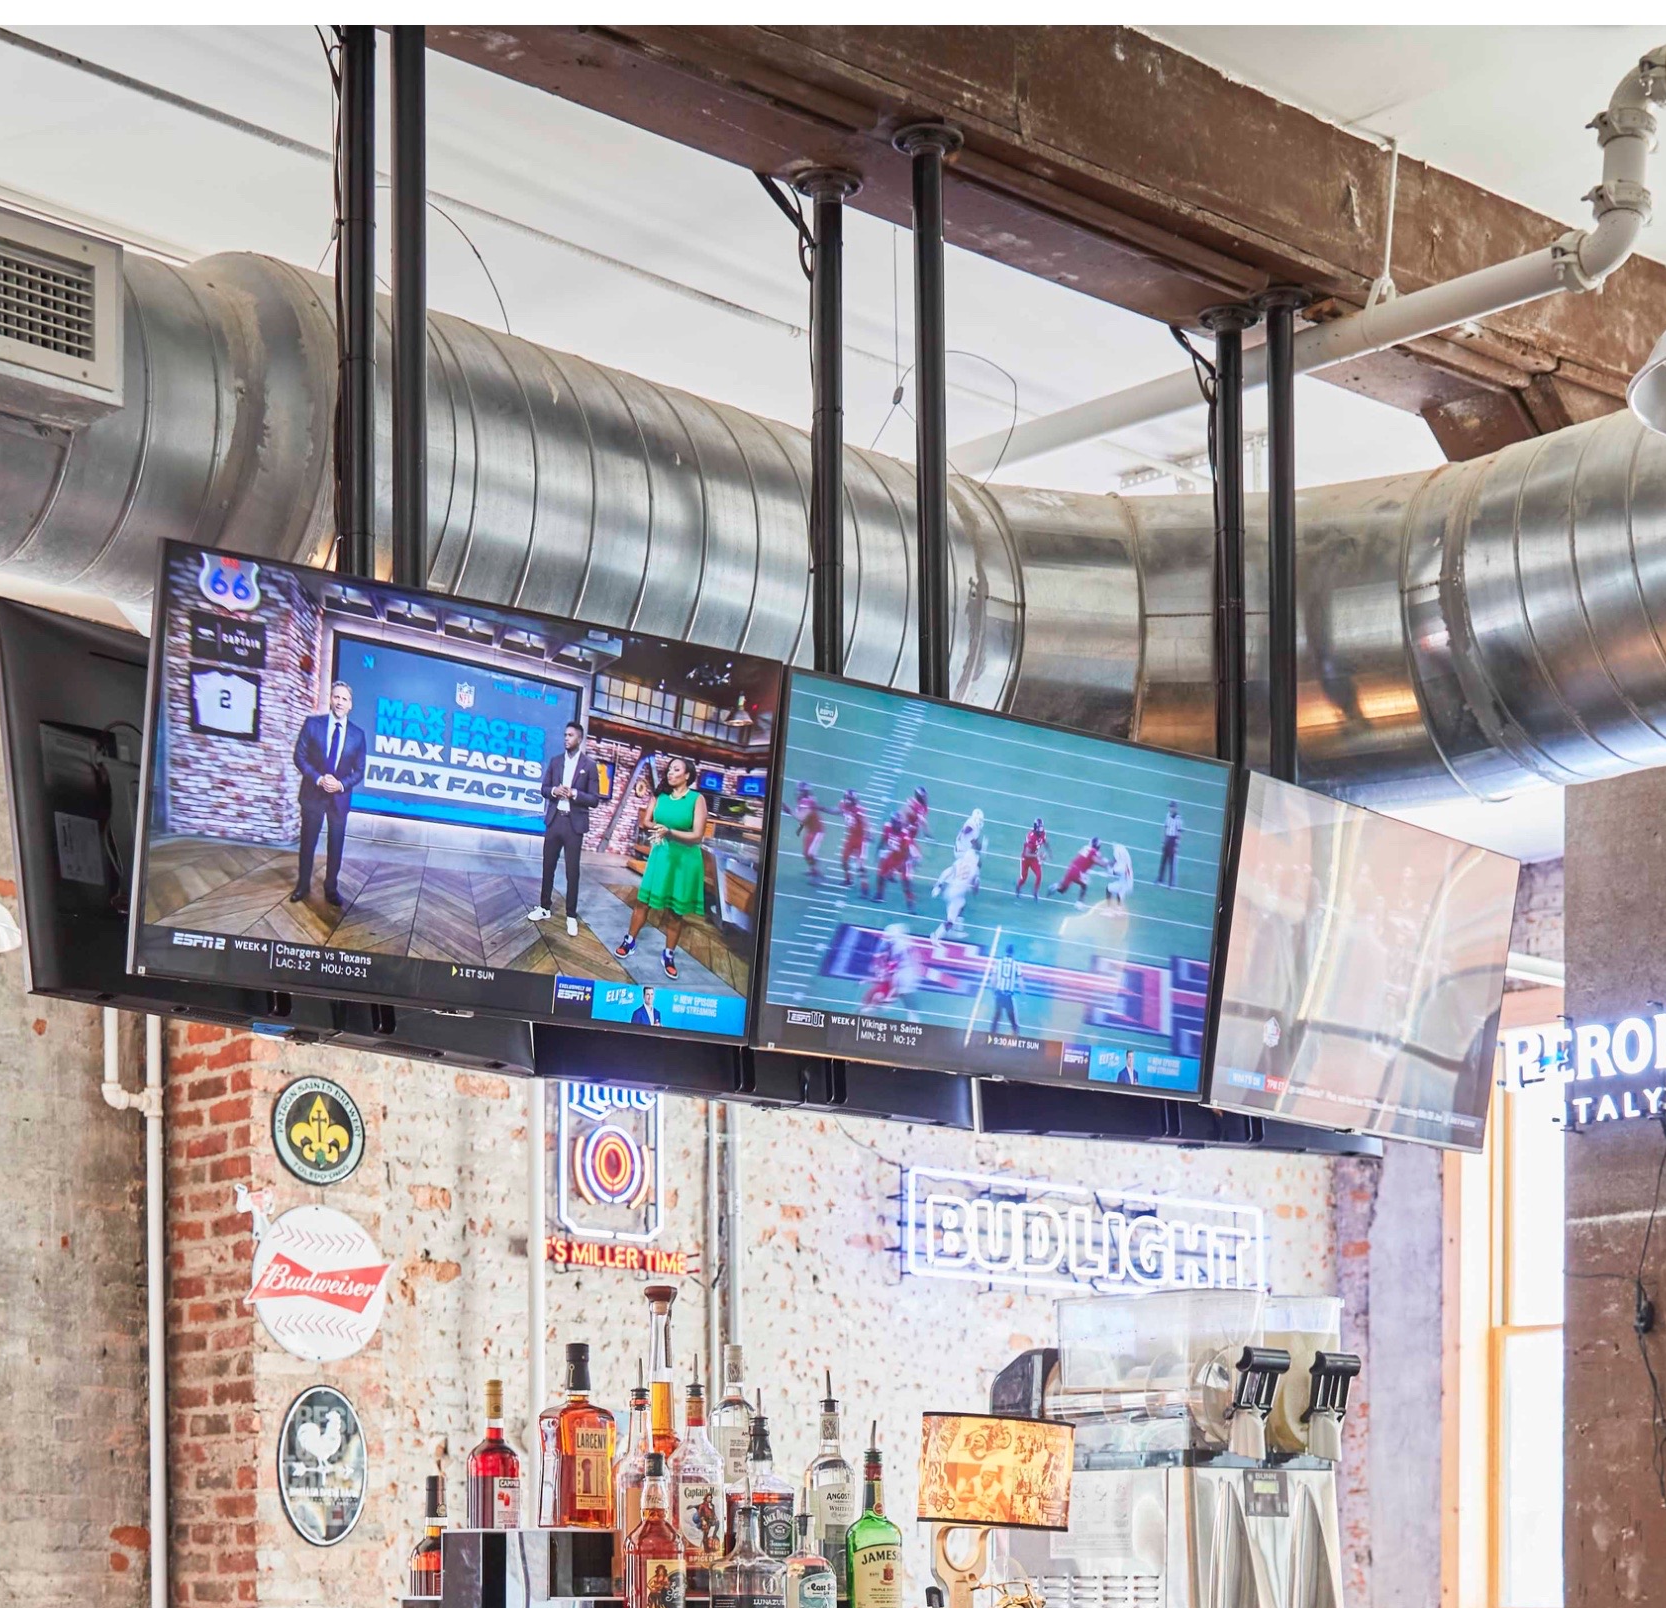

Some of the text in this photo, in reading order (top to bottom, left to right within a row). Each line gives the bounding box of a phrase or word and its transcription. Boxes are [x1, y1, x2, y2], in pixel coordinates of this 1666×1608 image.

[210, 568, 250, 600] 66
[220, 690, 232, 709] 2
[377, 697, 546, 746] MAX FACTS
[377, 717, 544, 761] MAX FACTS
[375, 735, 543, 778] MAX FACTS
[367, 764, 544, 804] MAX FACTS
[235, 940, 260, 951] WEEK
[261, 943, 268, 952] 4
[276, 944, 372, 965] Chargers vs Texans
[275, 958, 367, 977] LAC: 1-2 HOU: 0-2-1
[459, 968, 495, 980] 1 ET SUN
[605, 988, 627, 1003] ELI'S
[680, 995, 718, 1009] NEW EPISODE
[686, 1006, 717, 1018] STREAMING
[831, 1016, 850, 1026] WEEK
[851, 1018, 856, 1026] 4
[861, 1018, 923, 1035] Vikings vs Saints
[860, 1030, 916, 1046] MIN: 2-1 NO: 1-2
[993, 1037, 1039, 1050] 9:30 AM ET SUN
[277, 1082, 361, 1138] PATRON SAINTS BREWERY
[543, 1237, 688, 1275] T'S MILLER TIME
[261, 1263, 378, 1297] Budweiser
[577, 1432, 607, 1449] LARCENY
[1255, 1472, 1277, 1480] BUNN
[684, 1487, 707, 1499] Captain
[827, 1492, 853, 1500] ANGOST
[861, 1550, 901, 1565] JAMES
